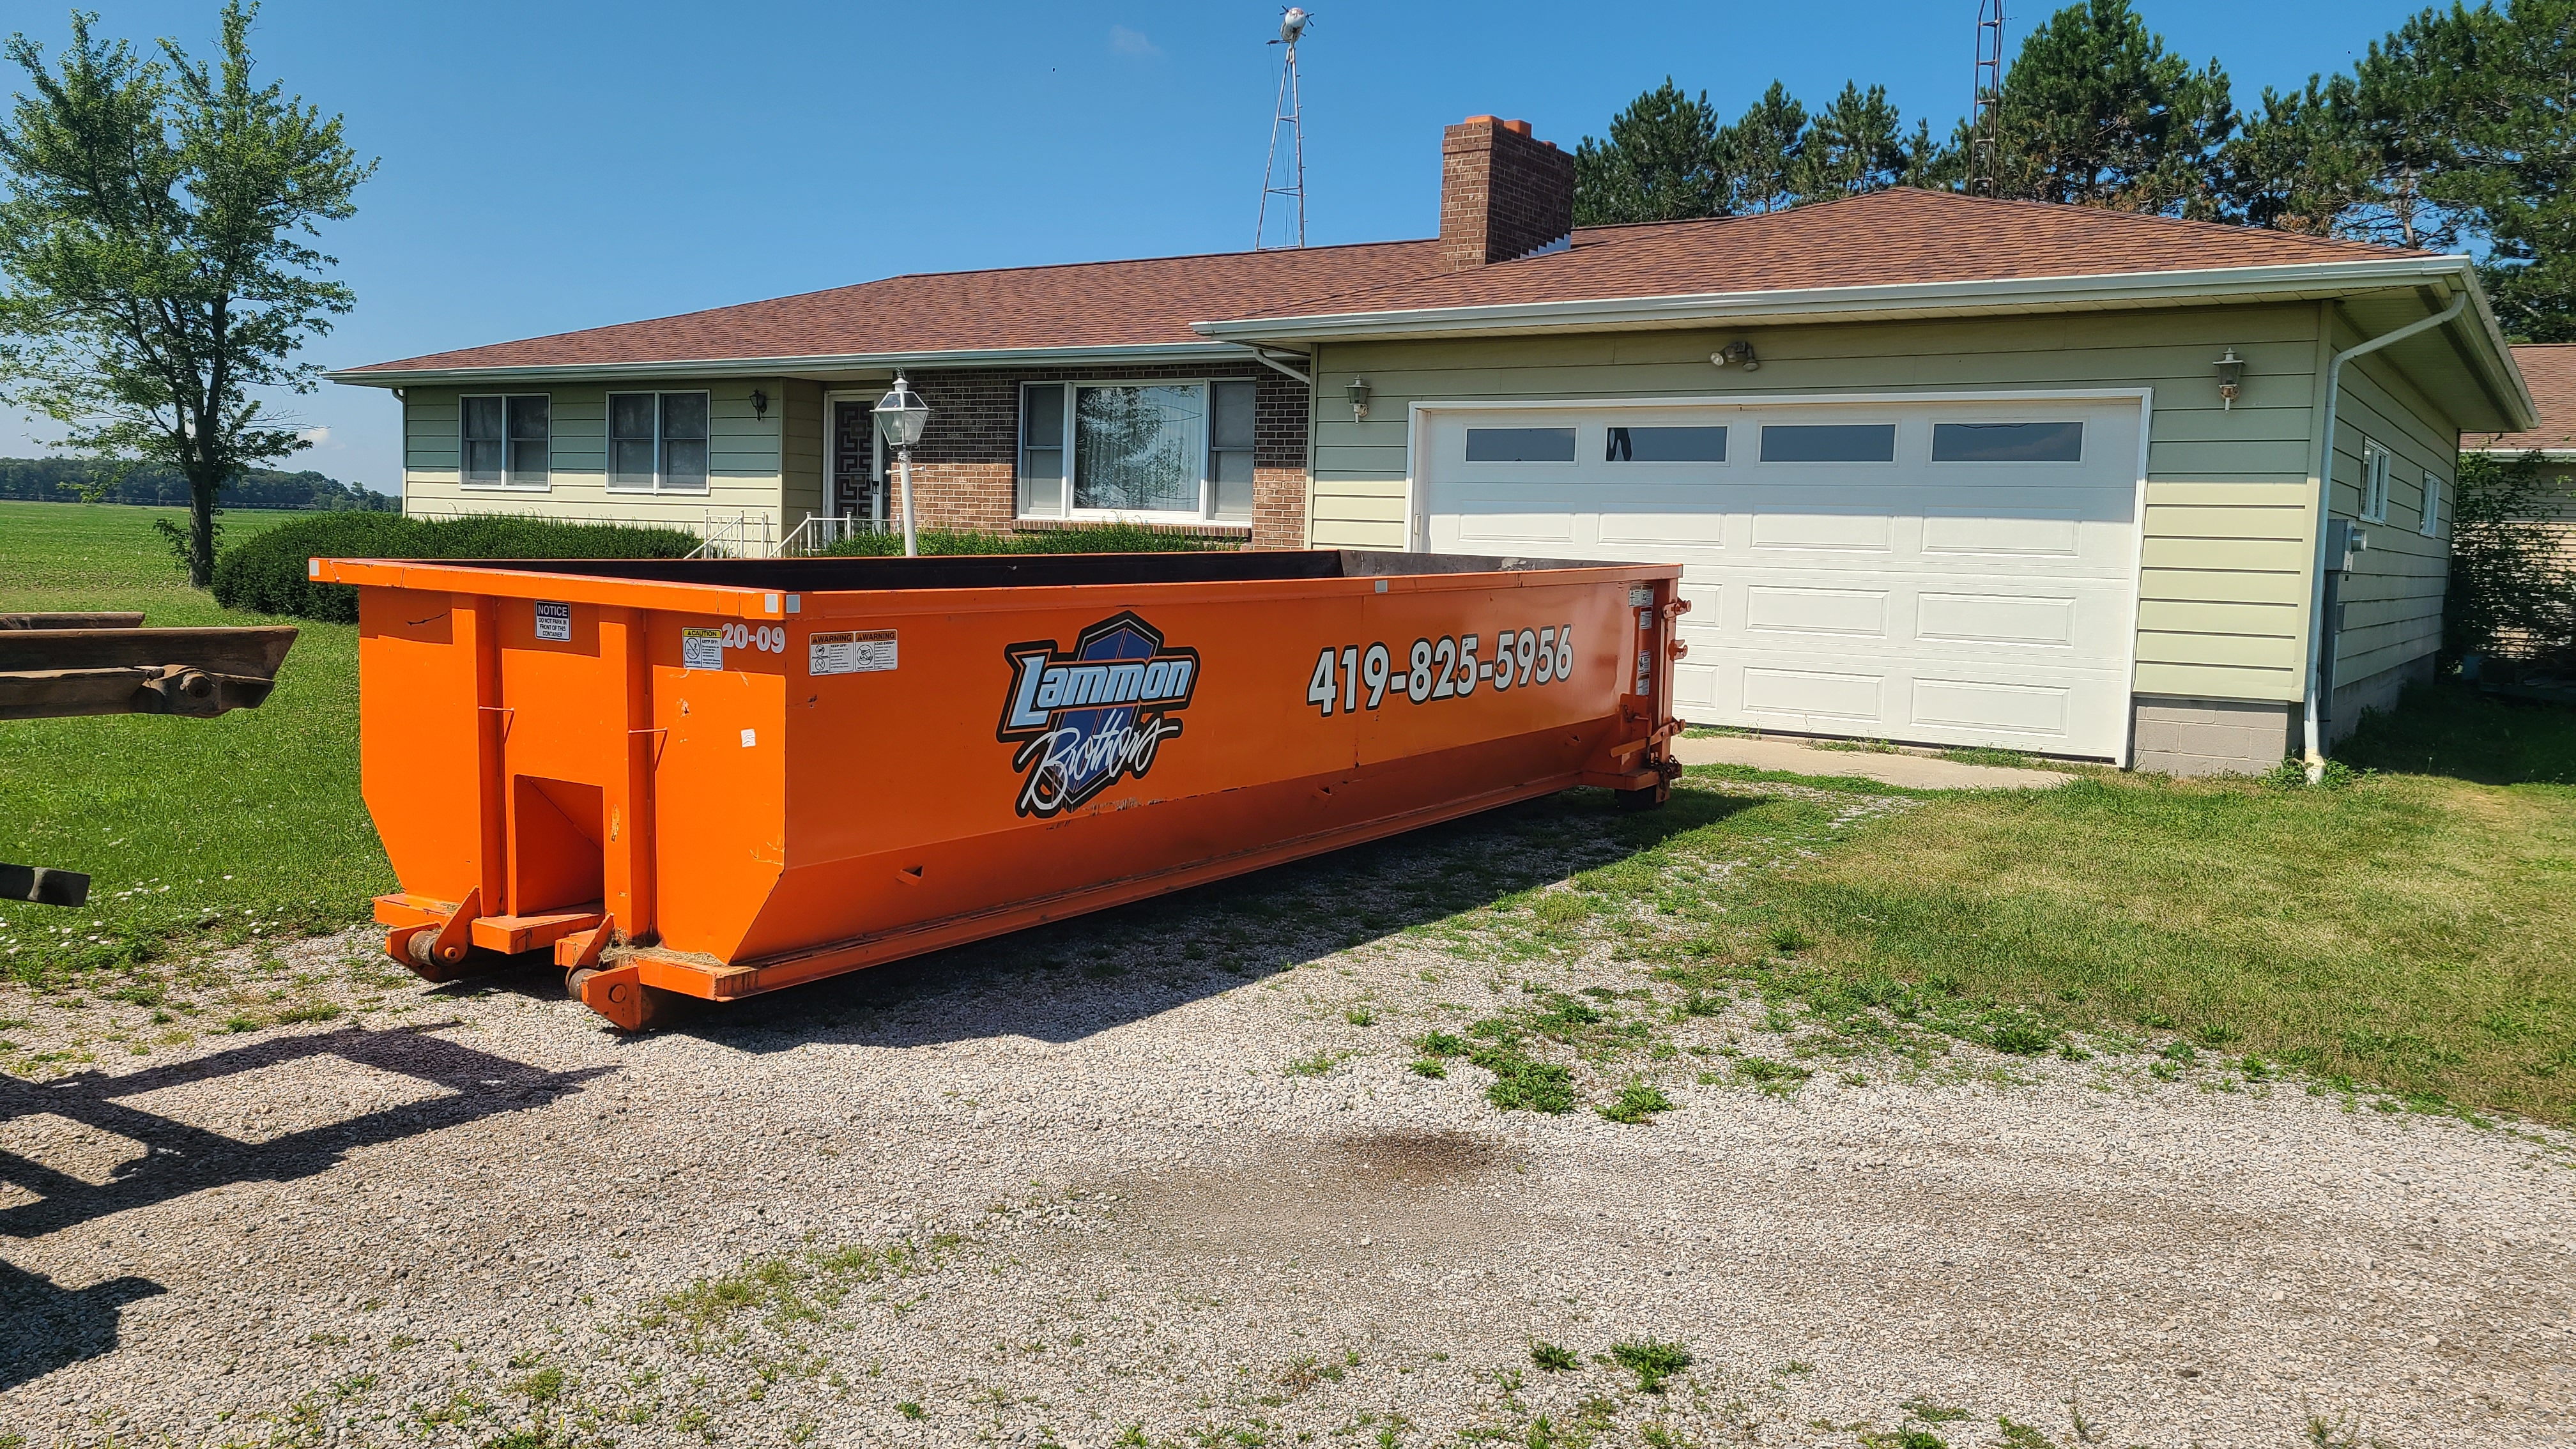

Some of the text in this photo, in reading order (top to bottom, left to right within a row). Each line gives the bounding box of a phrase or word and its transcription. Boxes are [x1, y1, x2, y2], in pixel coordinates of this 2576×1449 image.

[538, 605, 567, 616] NOTICE
[722, 623, 785, 653] 20-09
[818, 634, 852, 643] WARNING
[862, 632, 895, 641] WARNING
[1308, 624, 1573, 715] 419-825-5956
[1008, 654, 1193, 728] Lammon
[1017, 708, 1179, 811] Brothers
